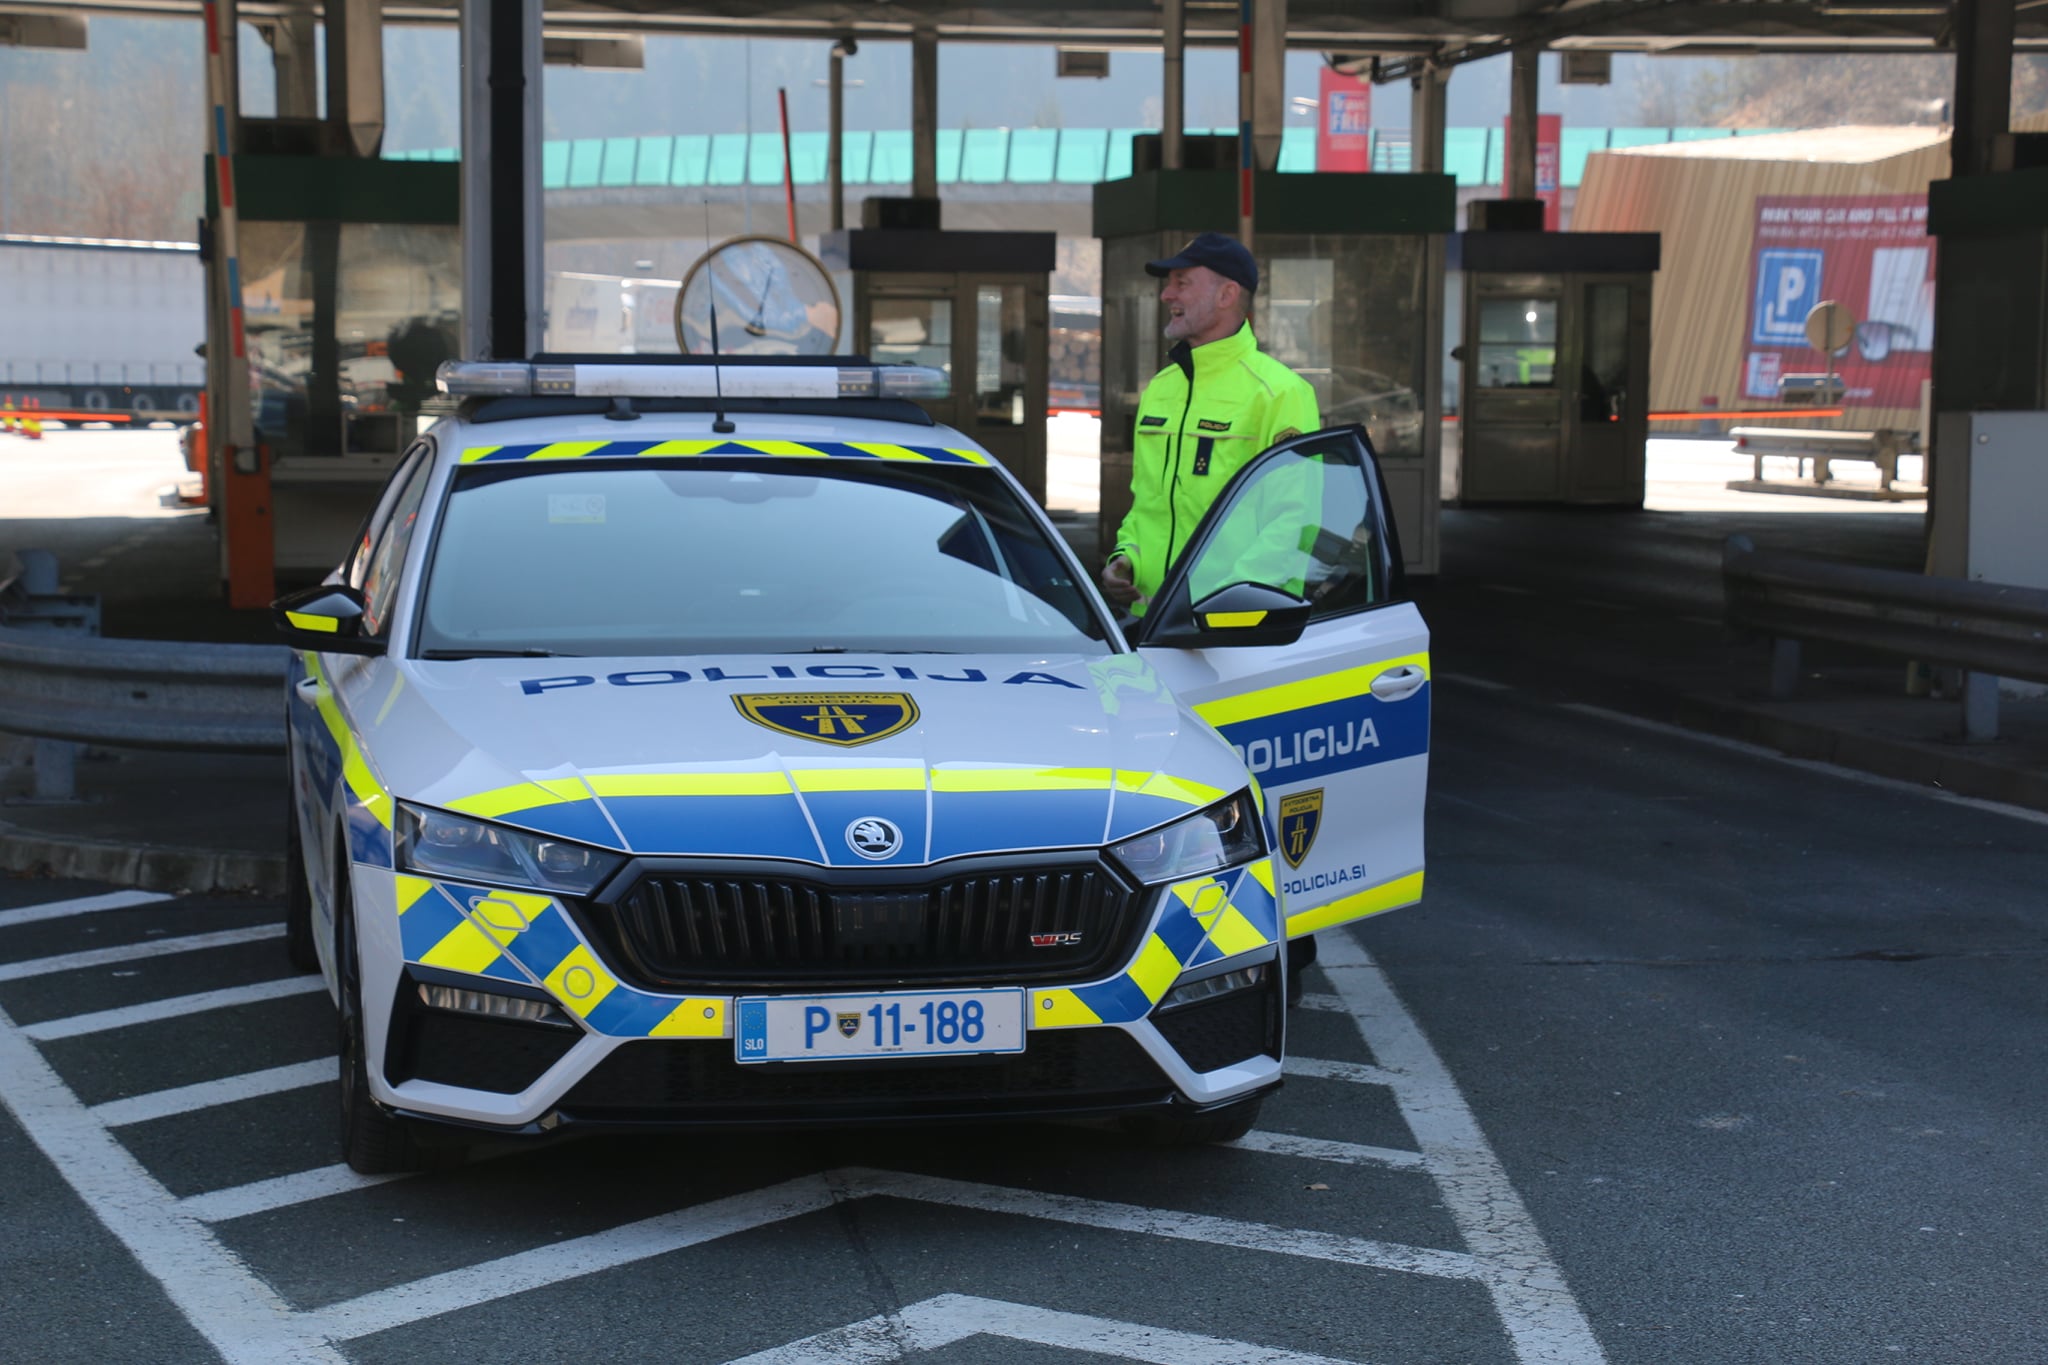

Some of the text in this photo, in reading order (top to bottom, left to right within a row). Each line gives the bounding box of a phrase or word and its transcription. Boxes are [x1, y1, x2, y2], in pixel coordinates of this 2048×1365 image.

[1776, 266, 1806, 317] P
[520, 665, 1088, 695] POLICIJA
[805, 1000, 985, 1049] P 11-188
[744, 1039, 764, 1051] SLO
